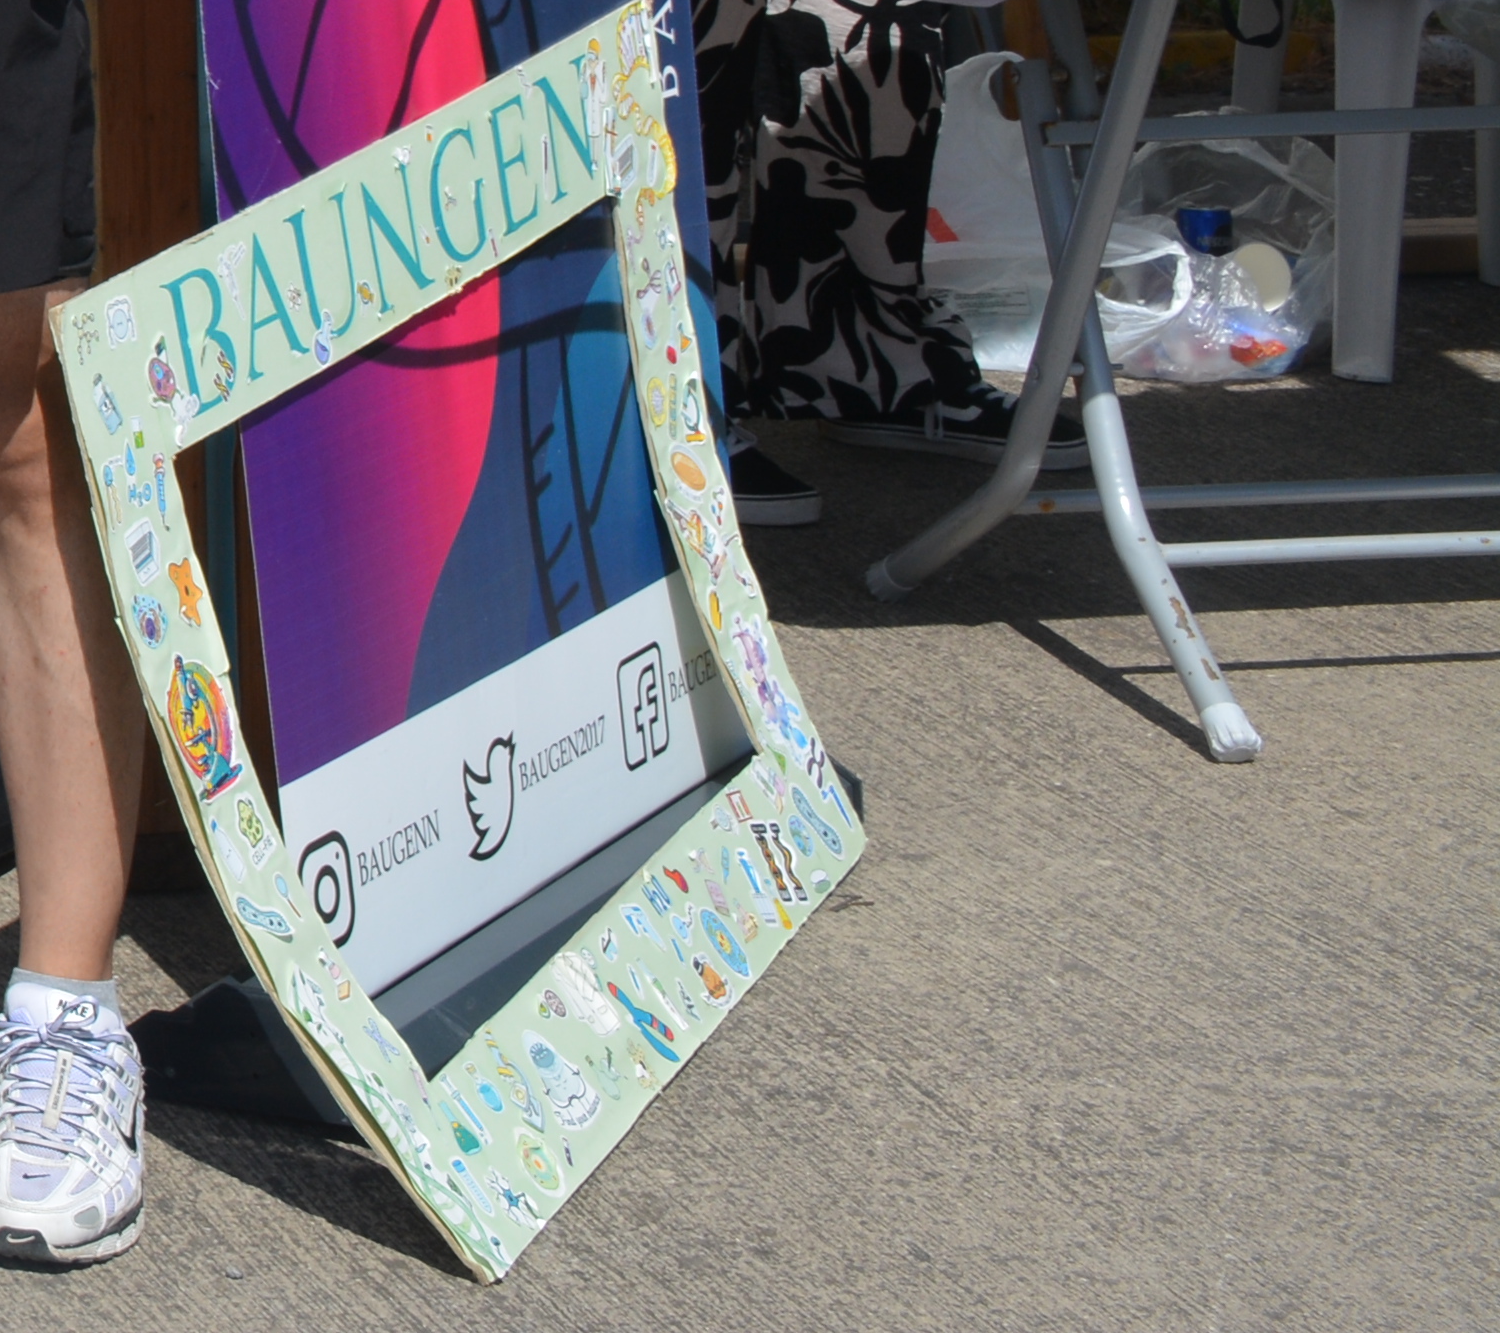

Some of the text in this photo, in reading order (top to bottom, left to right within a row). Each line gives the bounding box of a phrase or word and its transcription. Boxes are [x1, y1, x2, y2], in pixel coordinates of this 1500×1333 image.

[159, 54, 601, 417] BAUNGEN
[667, 648, 717, 704] BAUGE
[518, 715, 605, 792] BAUGEN2017
[356, 809, 442, 886] BAUGENN
[58, 999, 88, 1019] NKE
